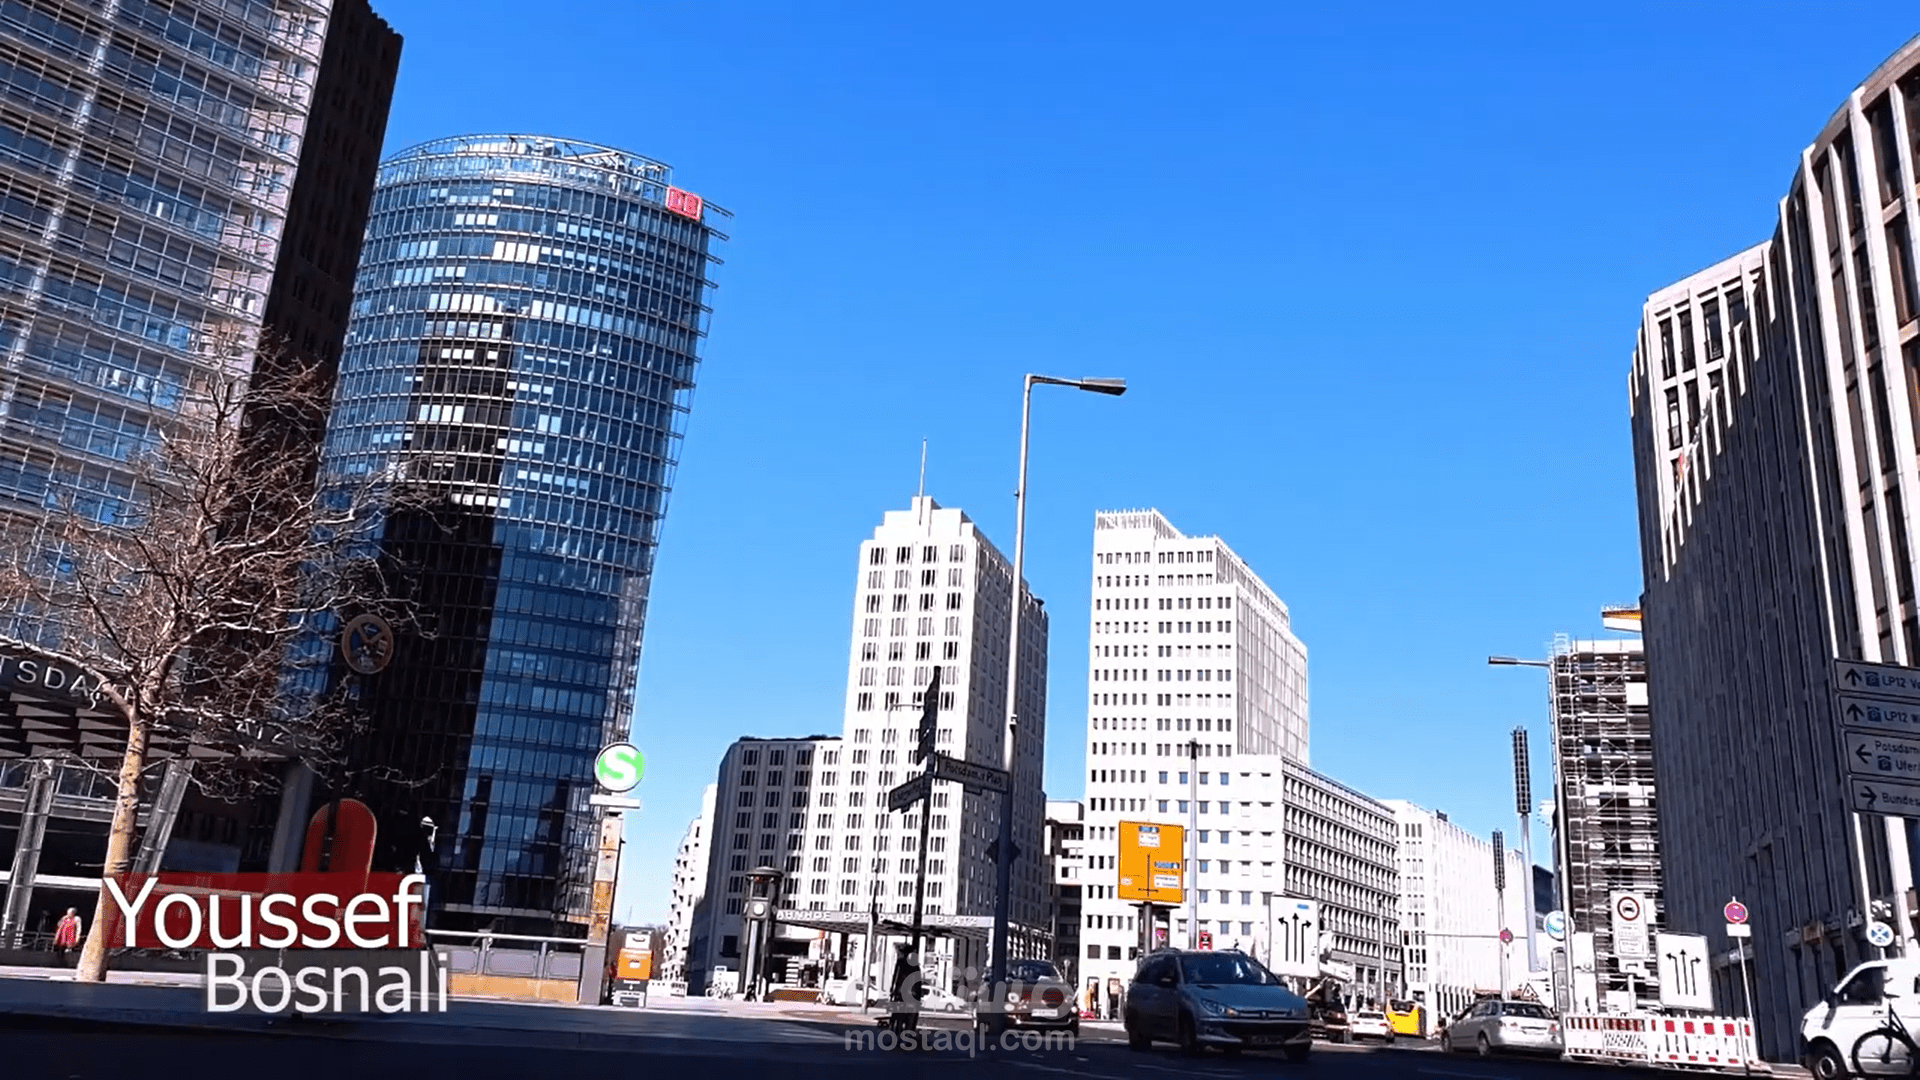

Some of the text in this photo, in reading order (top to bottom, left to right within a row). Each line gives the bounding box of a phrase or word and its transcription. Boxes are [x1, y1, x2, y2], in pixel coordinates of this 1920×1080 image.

[668, 188, 700, 218] DB
[1882, 675, 1906, 688] LP12
[1884, 710, 1908, 723] LP12
[603, 746, 636, 788] S
[1895, 759, 1920, 772] Ufer
[776, 909, 832, 922] AHNHOF
